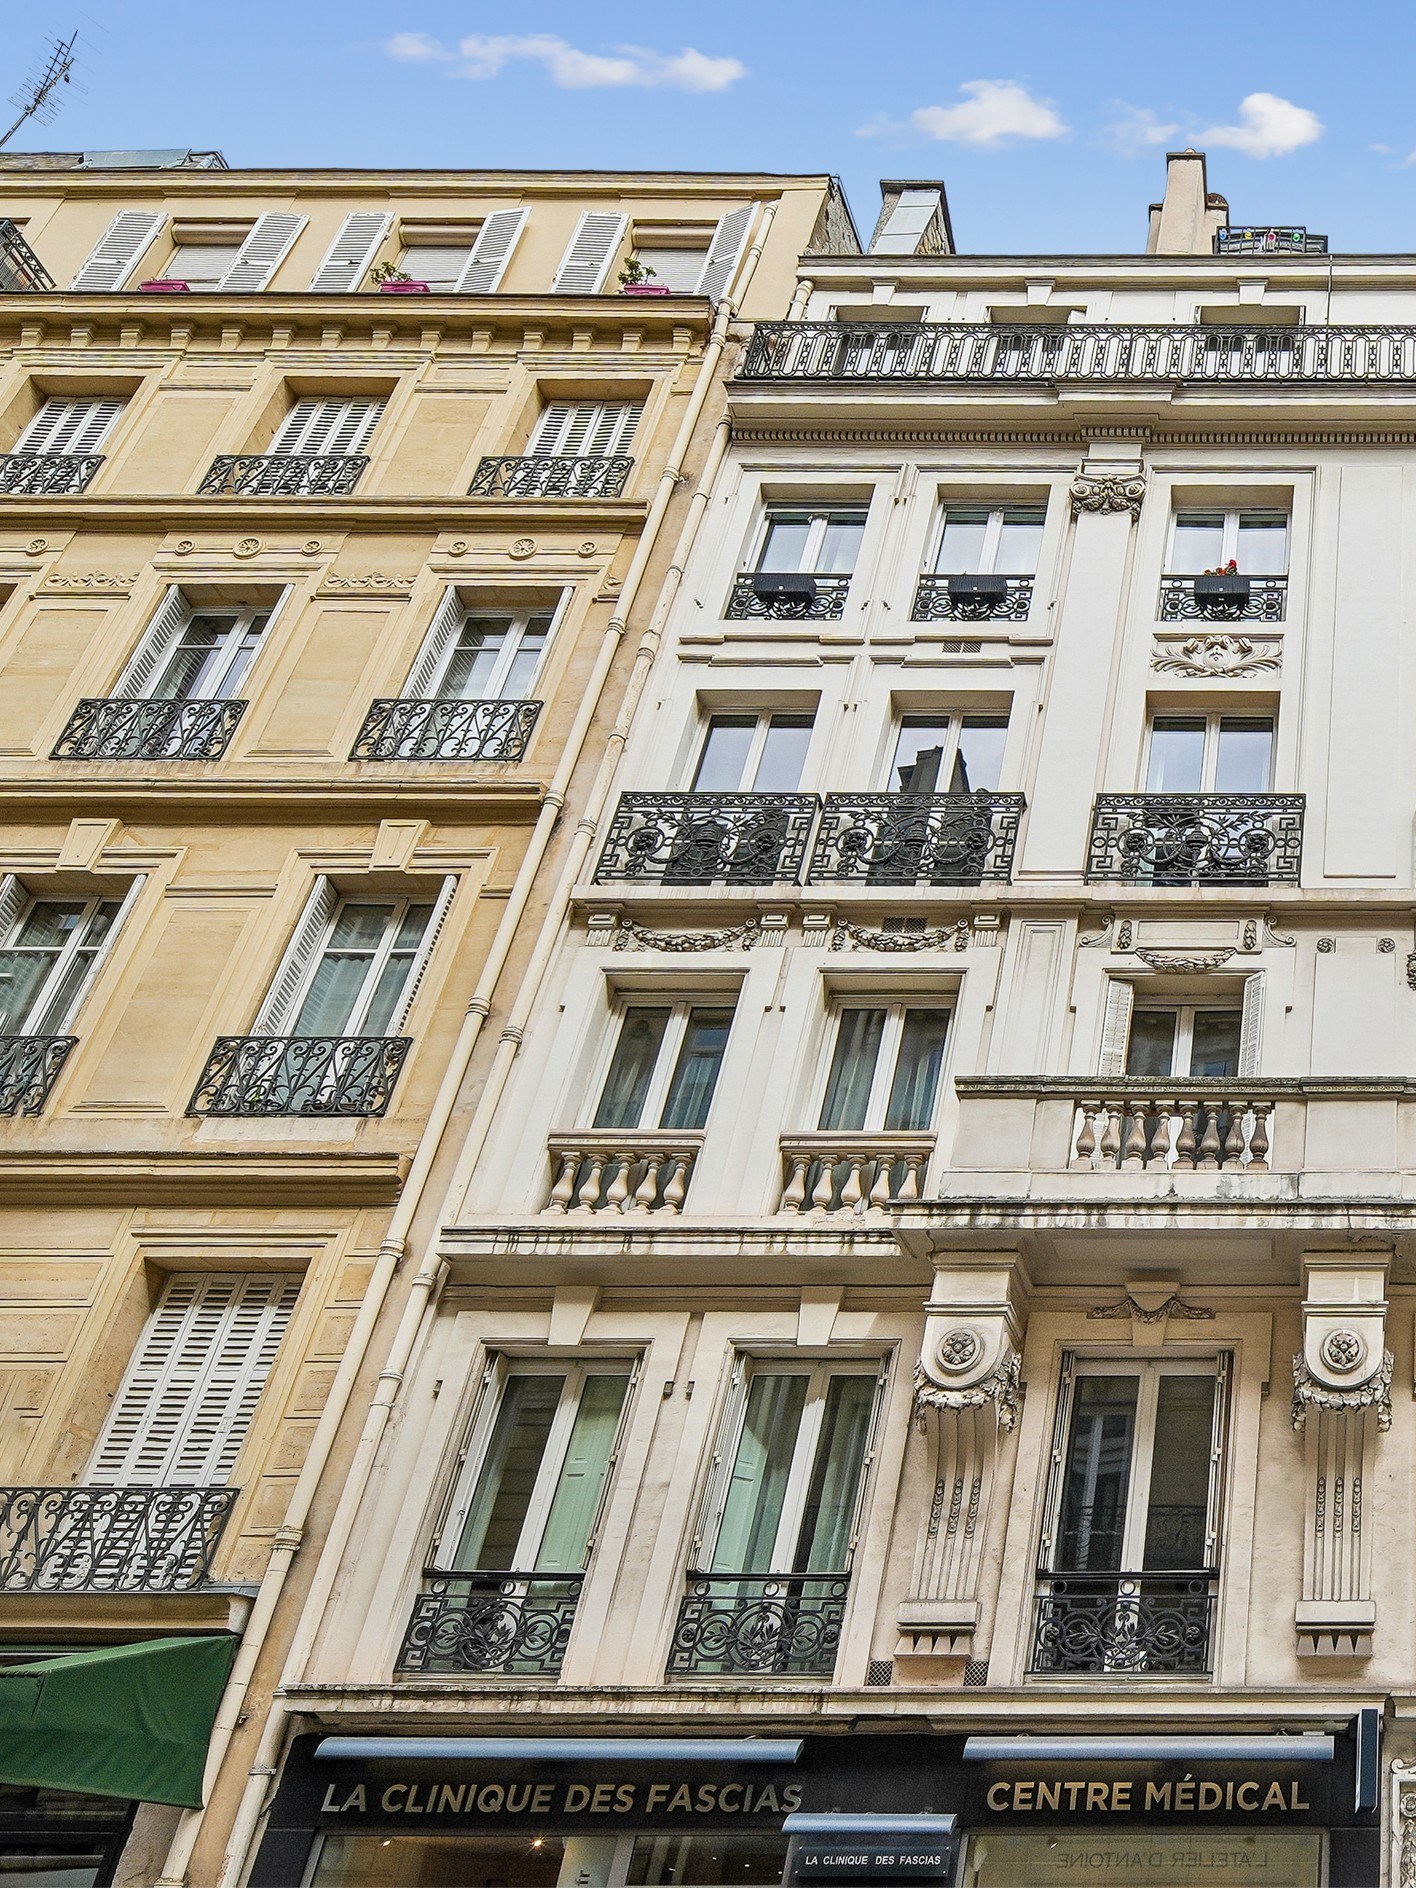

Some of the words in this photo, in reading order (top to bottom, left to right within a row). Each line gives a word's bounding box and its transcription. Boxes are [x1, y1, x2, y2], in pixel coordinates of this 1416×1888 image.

[320, 1783, 367, 1812] LA
[381, 1783, 556, 1813] CLINIQUE
[563, 1783, 636, 1813] DES
[645, 1783, 803, 1813] FASCIAS
[986, 1780, 1133, 1812] CENTRE
[1144, 1773, 1310, 1811] MÉDICAL
[805, 1856, 818, 1865] LA
[823, 1855, 869, 1866] CLINIQUE
[875, 1855, 895, 1866] DES
[899, 1855, 942, 1866] FASCIAS
